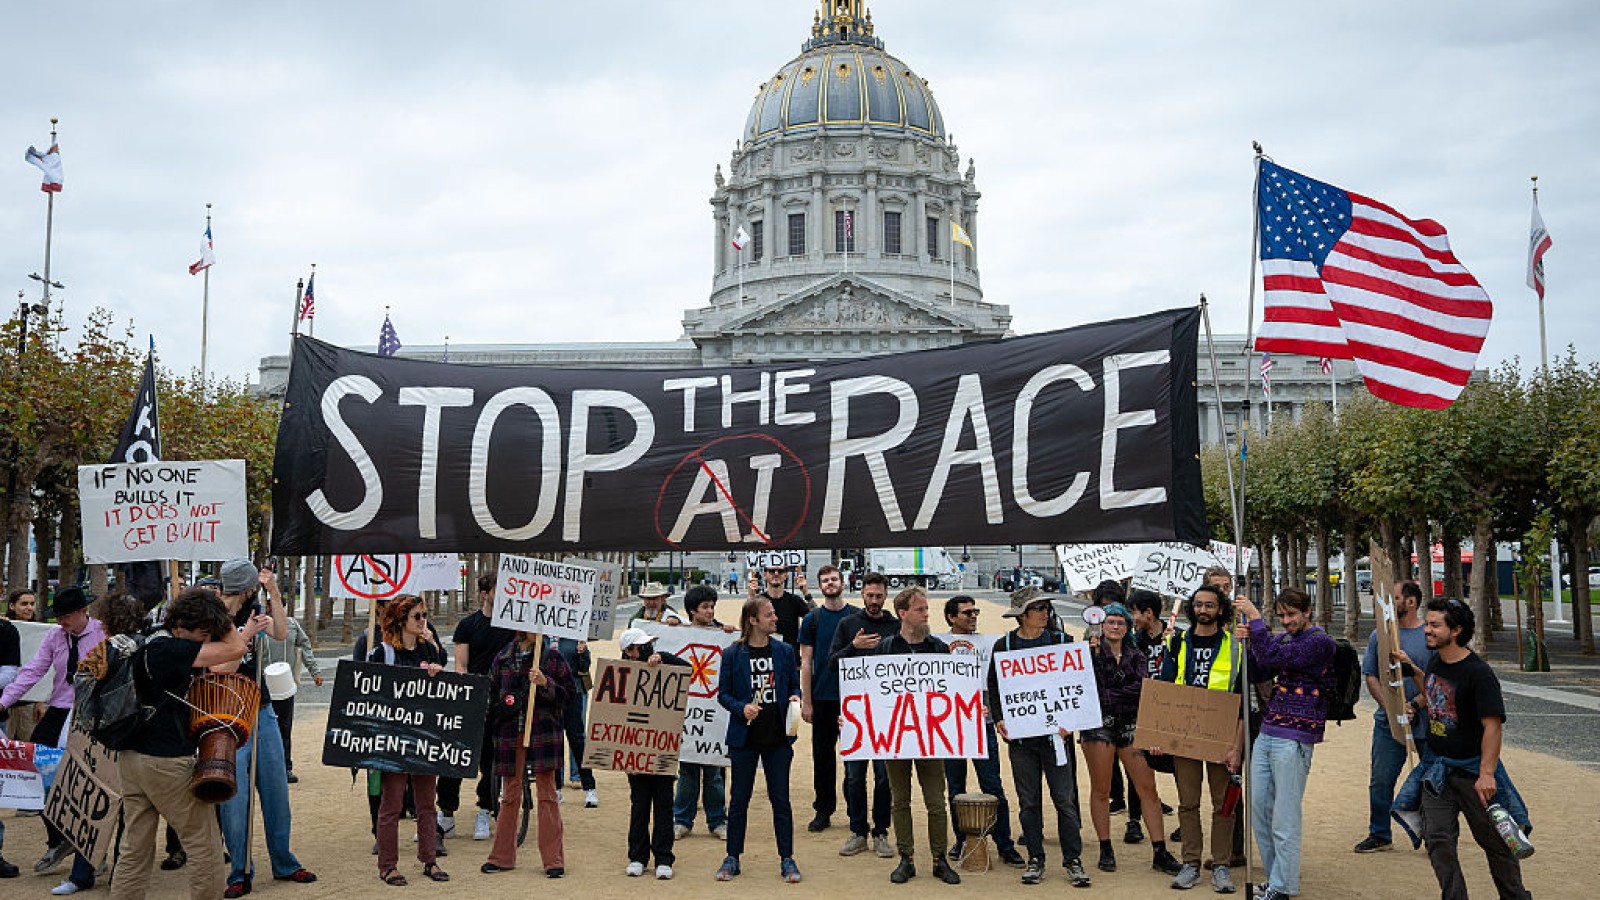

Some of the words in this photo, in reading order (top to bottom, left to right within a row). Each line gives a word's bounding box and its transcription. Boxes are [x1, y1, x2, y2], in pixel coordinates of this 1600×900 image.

[663, 368, 816, 432] THE
[820, 349, 1170, 534] RACE
[304, 373, 656, 542] STOP
[94, 467, 117, 489] IF
[126, 468, 154, 488] NO
[158, 468, 201, 484] ONE
[114, 490, 169, 504] BUILDS
[176, 491, 195, 506] IT
[667, 454, 783, 544] AI
[105, 508, 121, 527] IT
[130, 504, 179, 523] DOES
[190, 502, 225, 518] NOT
[123, 524, 158, 550] GET
[167, 520, 221, 543] BUILT
[345, 553, 399, 585] ASI
[502, 557, 529, 575] AND
[533, 558, 596, 584] HONESTLY?
[747, 554, 768, 568] WE
[770, 552, 802, 566] DID
[1074, 556, 1121, 574] RUNS
[1085, 564, 1135, 585] FAIL
[1144, 552, 1206, 582] SATISF
[504, 577, 553, 599] STOP
[560, 588, 582, 605] the
[500, 600, 526, 623] AI
[535, 607, 588, 634] RACE!
[840, 660, 870, 681] task
[874, 657, 982, 679] environment
[1000, 652, 1058, 679] PAUSE
[1061, 648, 1085, 673] AI
[353, 671, 382, 695] YOU
[393, 679, 474, 701] WOULDN'T
[595, 664, 631, 705] AI
[633, 668, 693, 712] RACE
[880, 676, 948, 696] seems
[1005, 688, 1048, 706] BEFORE
[1059, 685, 1084, 699] IT'S
[346, 702, 424, 726] DOWNLOAD
[436, 713, 463, 730] THE
[1008, 704, 1037, 718] TOO
[1044, 698, 1080, 714] LATE
[590, 723, 681, 752] EXTINCTION
[840, 689, 984, 759] SWARM
[331, 728, 410, 756] TORMENT
[416, 740, 472, 767] NEXUS
[612, 749, 657, 774] RACE
[61, 753, 110, 821] NERD
[47, 785, 100, 860] REICH
